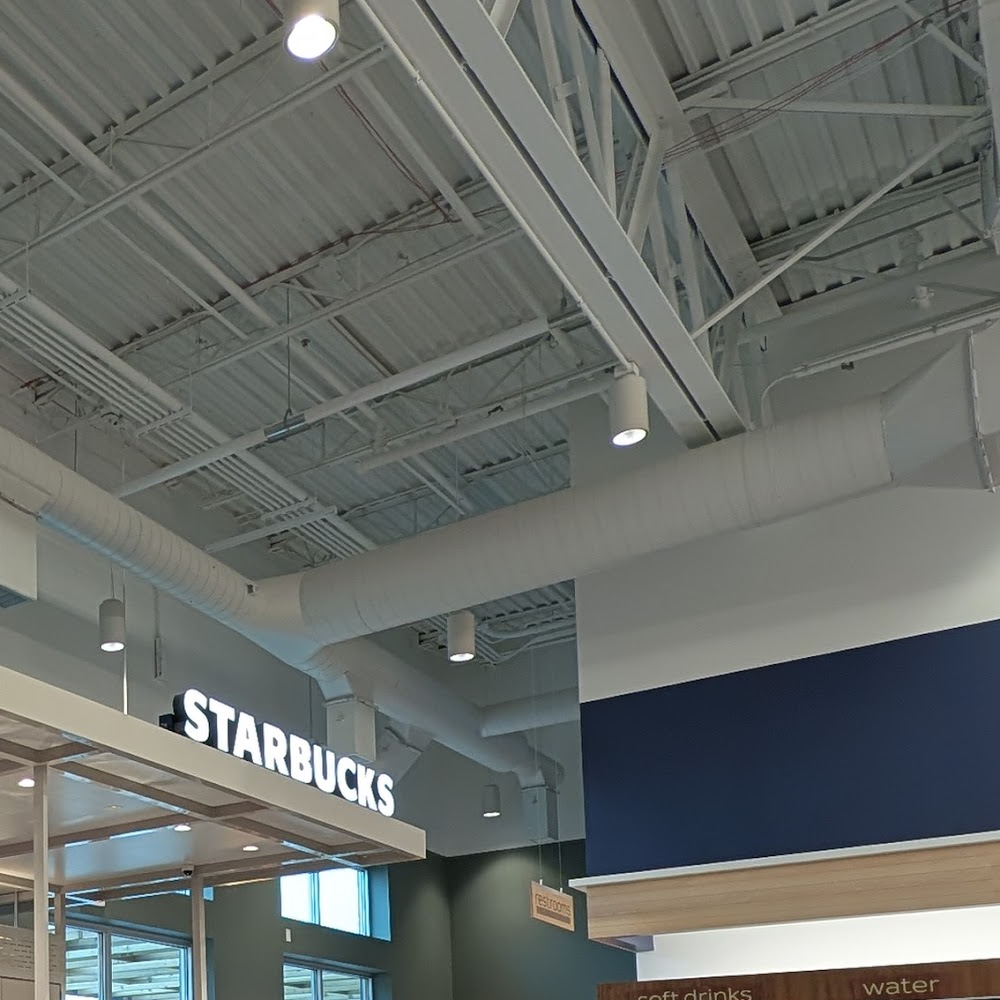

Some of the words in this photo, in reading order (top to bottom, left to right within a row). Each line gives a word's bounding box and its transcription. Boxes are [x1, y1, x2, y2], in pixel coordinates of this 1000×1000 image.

[183, 688, 395, 817] STARBUCKS
[534, 893, 571, 916] restrooms
[863, 977, 939, 996] water
